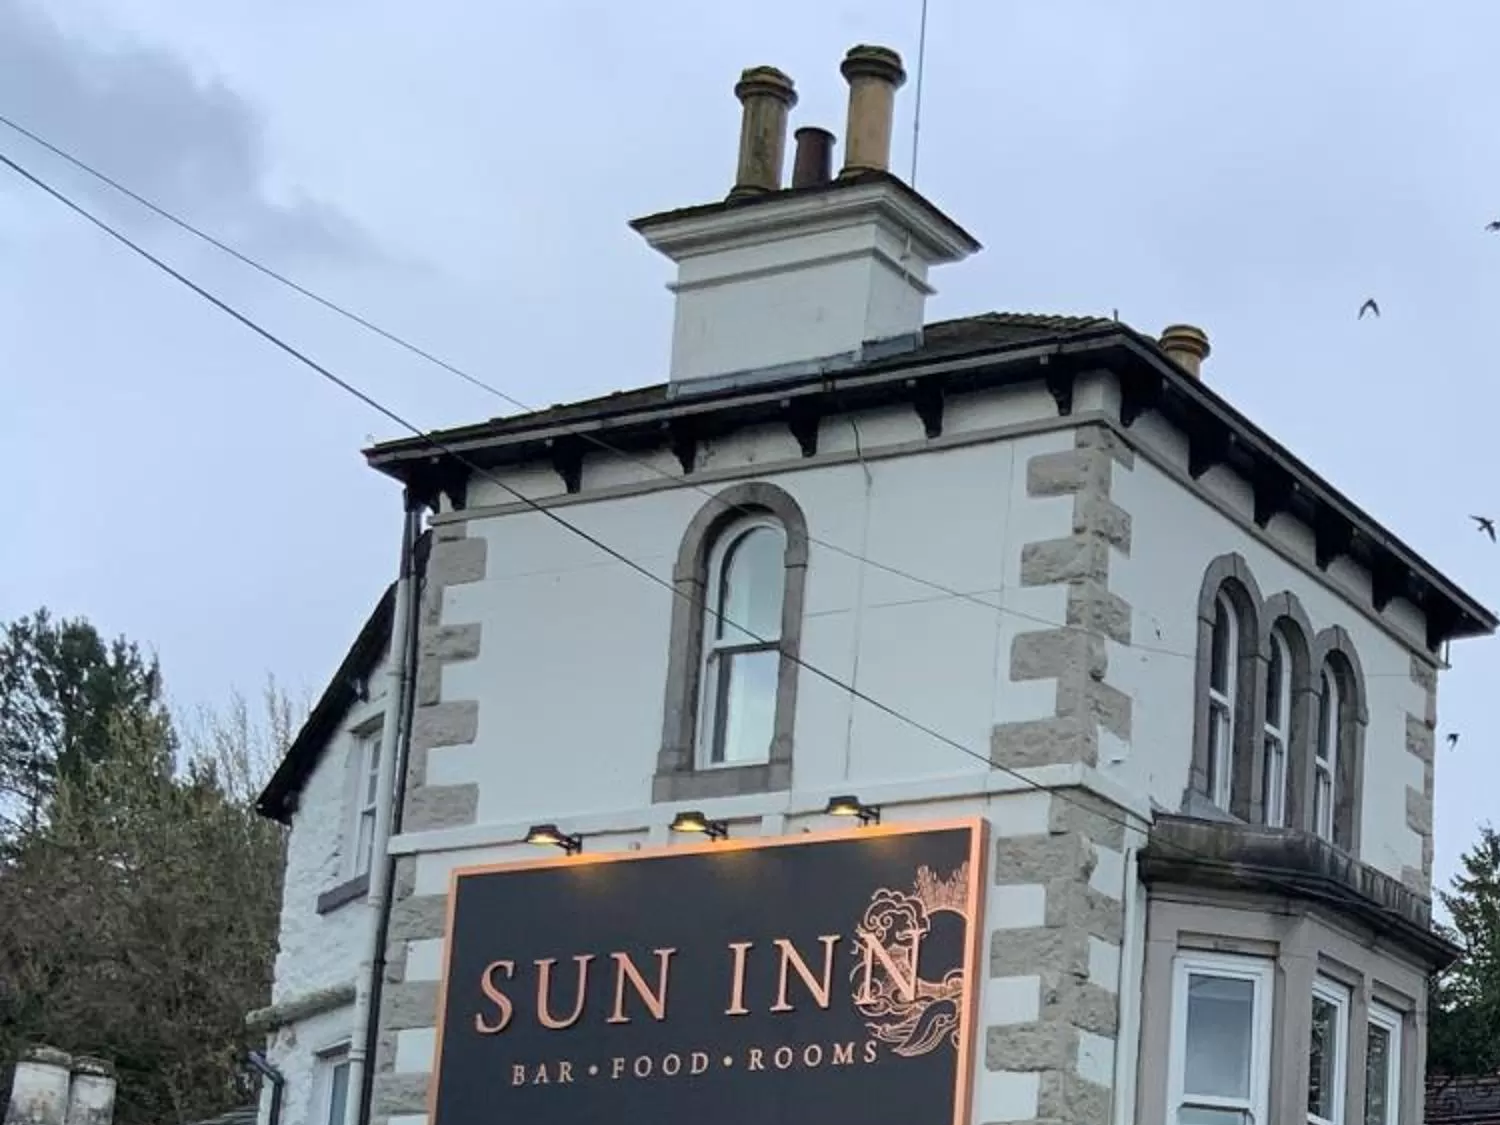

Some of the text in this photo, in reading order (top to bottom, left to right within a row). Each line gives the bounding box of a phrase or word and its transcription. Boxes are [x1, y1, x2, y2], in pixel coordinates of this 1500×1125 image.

[474, 929, 922, 1035] SUN INN
[513, 1040, 879, 1086] BAR FOOD ROOMS
